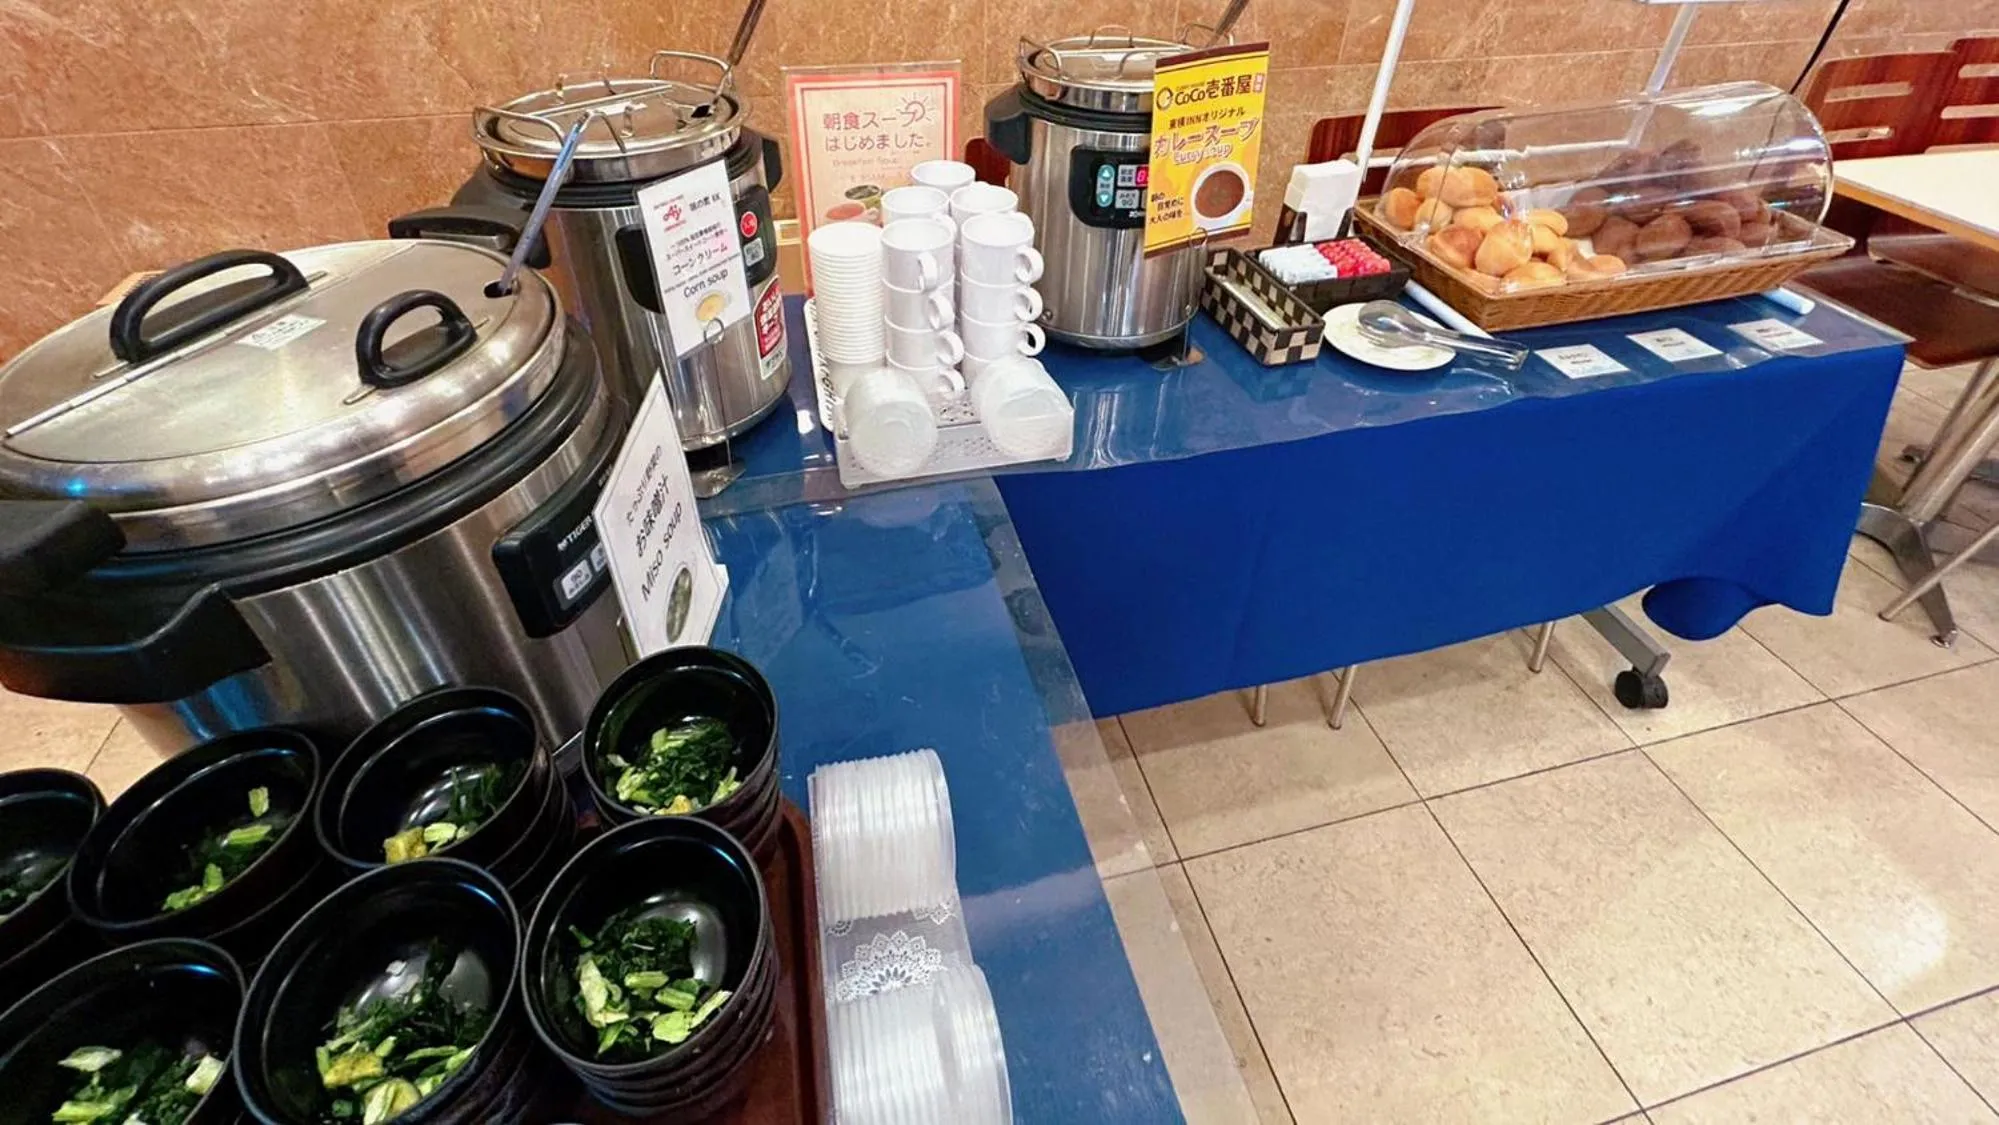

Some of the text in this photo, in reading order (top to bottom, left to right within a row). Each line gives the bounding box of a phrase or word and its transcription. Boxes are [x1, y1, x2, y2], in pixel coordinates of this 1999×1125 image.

[1175, 75, 1252, 106] CoCo壱番屋
[823, 101, 926, 131] 朝食スープ
[1155, 117, 1260, 158] カレースープ
[683, 276, 706, 298] Corn
[707, 268, 729, 287] soup
[566, 515, 592, 543] TIGER
[636, 473, 669, 558] お味噌汁
[641, 501, 682, 602] Miso soup
